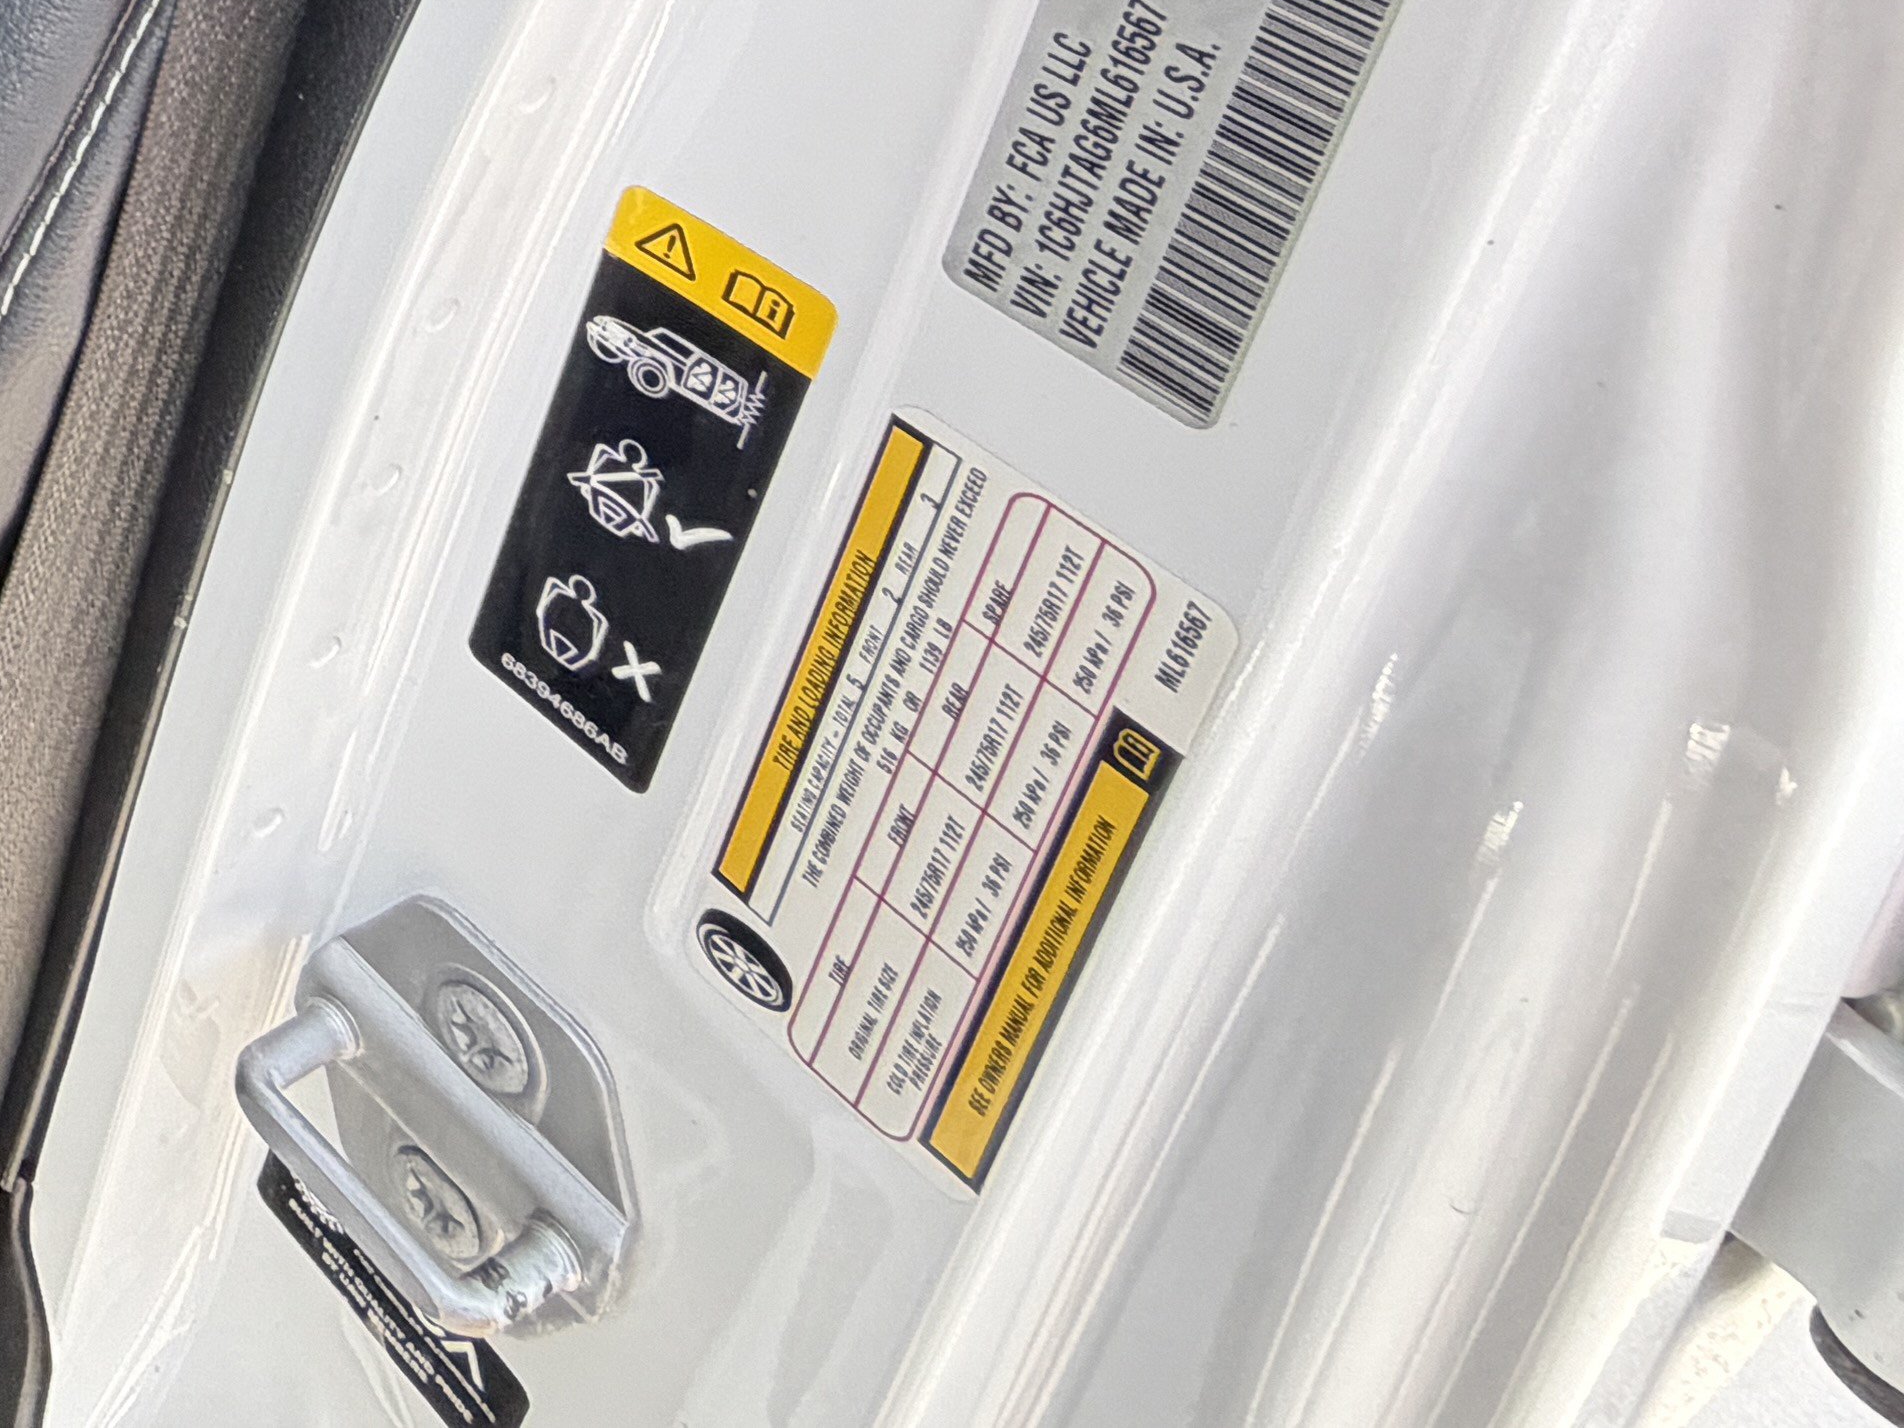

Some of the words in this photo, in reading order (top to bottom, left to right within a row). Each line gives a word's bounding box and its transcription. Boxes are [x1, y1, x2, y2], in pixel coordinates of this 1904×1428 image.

[1041, 28, 1092, 87] LLC
[1151, 27, 1221, 122] U.S.A.
[1025, 79, 1072, 129] US
[1004, 120, 1056, 183] FCA
[1134, 114, 1185, 166] IN:
[985, 177, 1033, 233] BY:
[1102, 157, 1167, 246] MADE
[962, 223, 1015, 294] MFD
[1009, 256, 1063, 324] VIN:
[1058, 236, 1133, 354] VEHICLE
[954, 465, 987, 518] EXCEED
[936, 513, 967, 560] NEVER
[821, 548, 876, 651] INFORMATION
[915, 554, 950, 609] SHOULD
[898, 603, 929, 651] CARGO
[1153, 598, 1213, 694] ML616567
[798, 644, 838, 712] LOADING
[887, 644, 912, 677] AND
[500, 652, 628, 765] 68394686AB
[786, 705, 813, 742] AND
[857, 670, 900, 746] OCCUPANTS
[773, 734, 800, 774] TIRE
[853, 740, 872, 763] OF
[835, 757, 865, 807] WEIGHT
[810, 801, 847, 866] COMBINED
[1063, 814, 1117, 904] INFORMATION
[801, 859, 823, 889] THE
[1032, 896, 1077, 973] ADDITIONAL
[1021, 965, 1046, 998] FOR
[999, 992, 1034, 1047] MANUAL
[977, 1039, 1013, 1095] OWNERS
[966, 1086, 991, 1117] SEE
